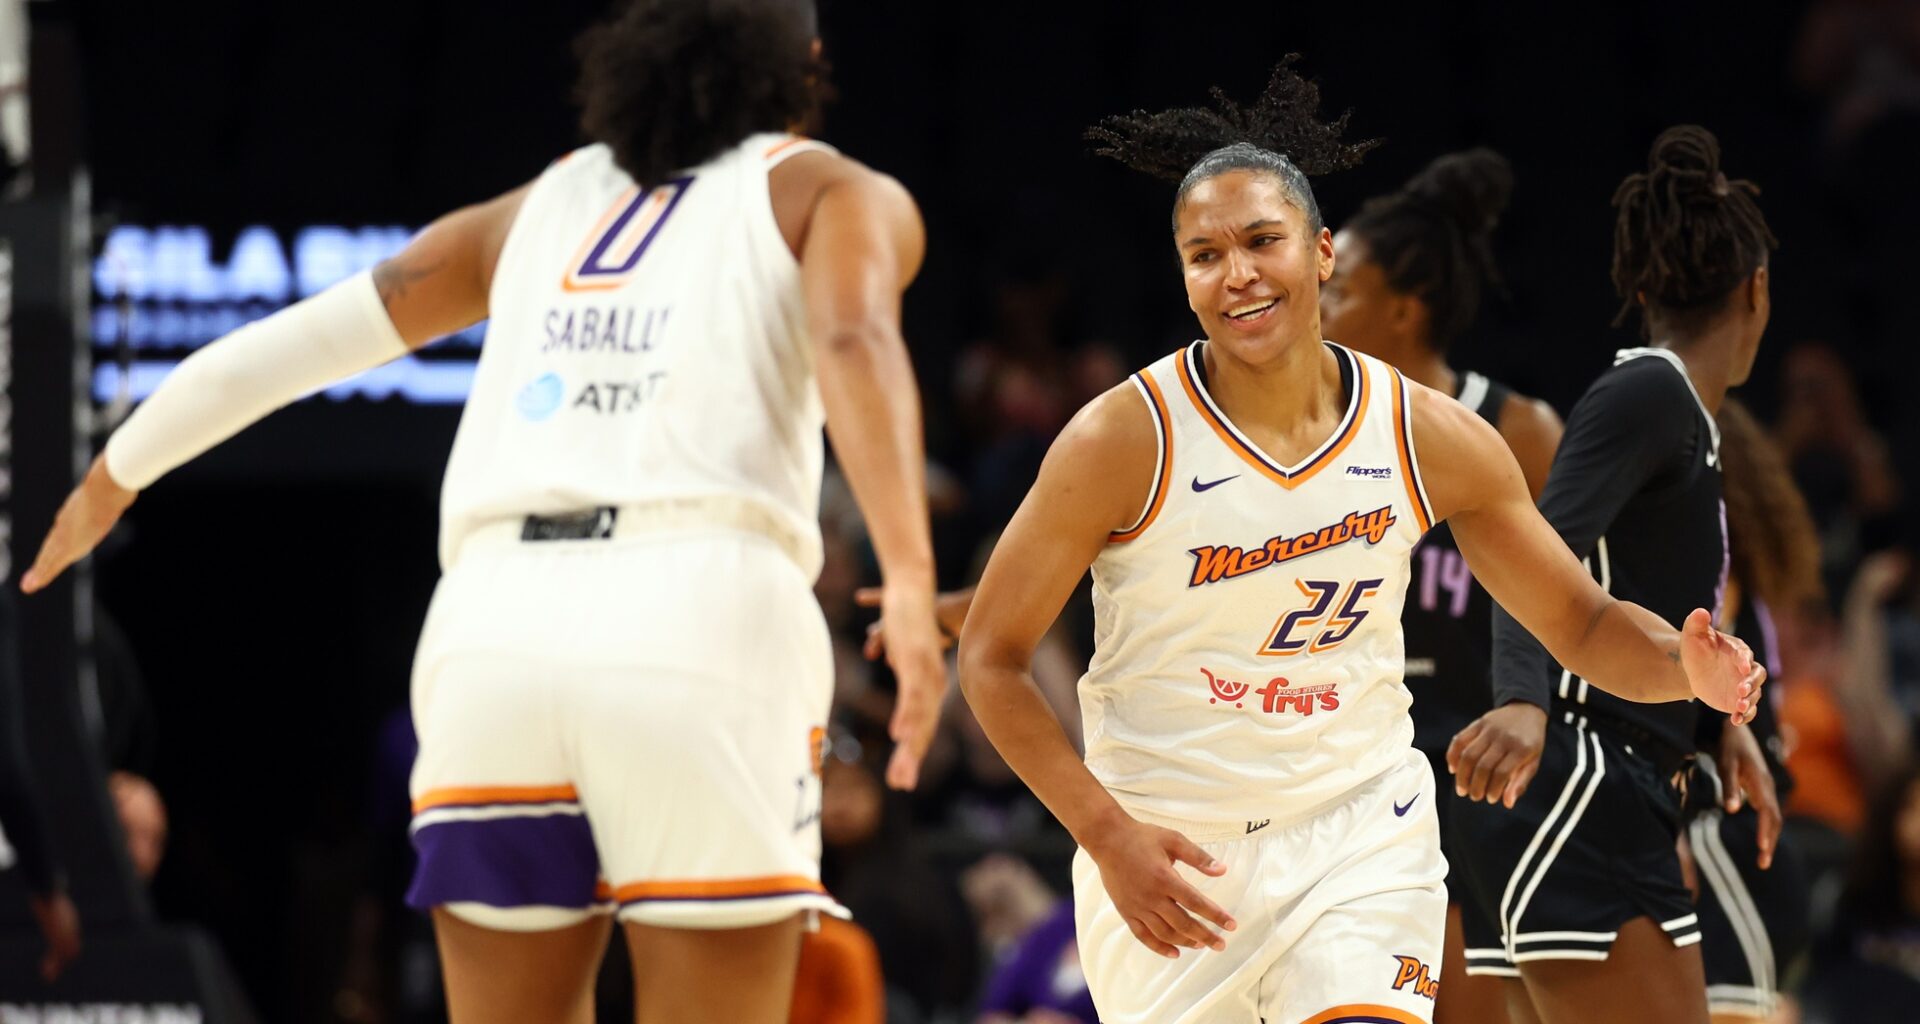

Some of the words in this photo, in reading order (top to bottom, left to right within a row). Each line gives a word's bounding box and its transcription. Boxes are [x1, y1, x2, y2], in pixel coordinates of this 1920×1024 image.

[560, 173, 697, 292] 0
[1187, 504, 1397, 590] Mercury
[1420, 546, 1472, 617] 14
[1256, 577, 1384, 656] 25
[1254, 677, 1340, 716] fry's
